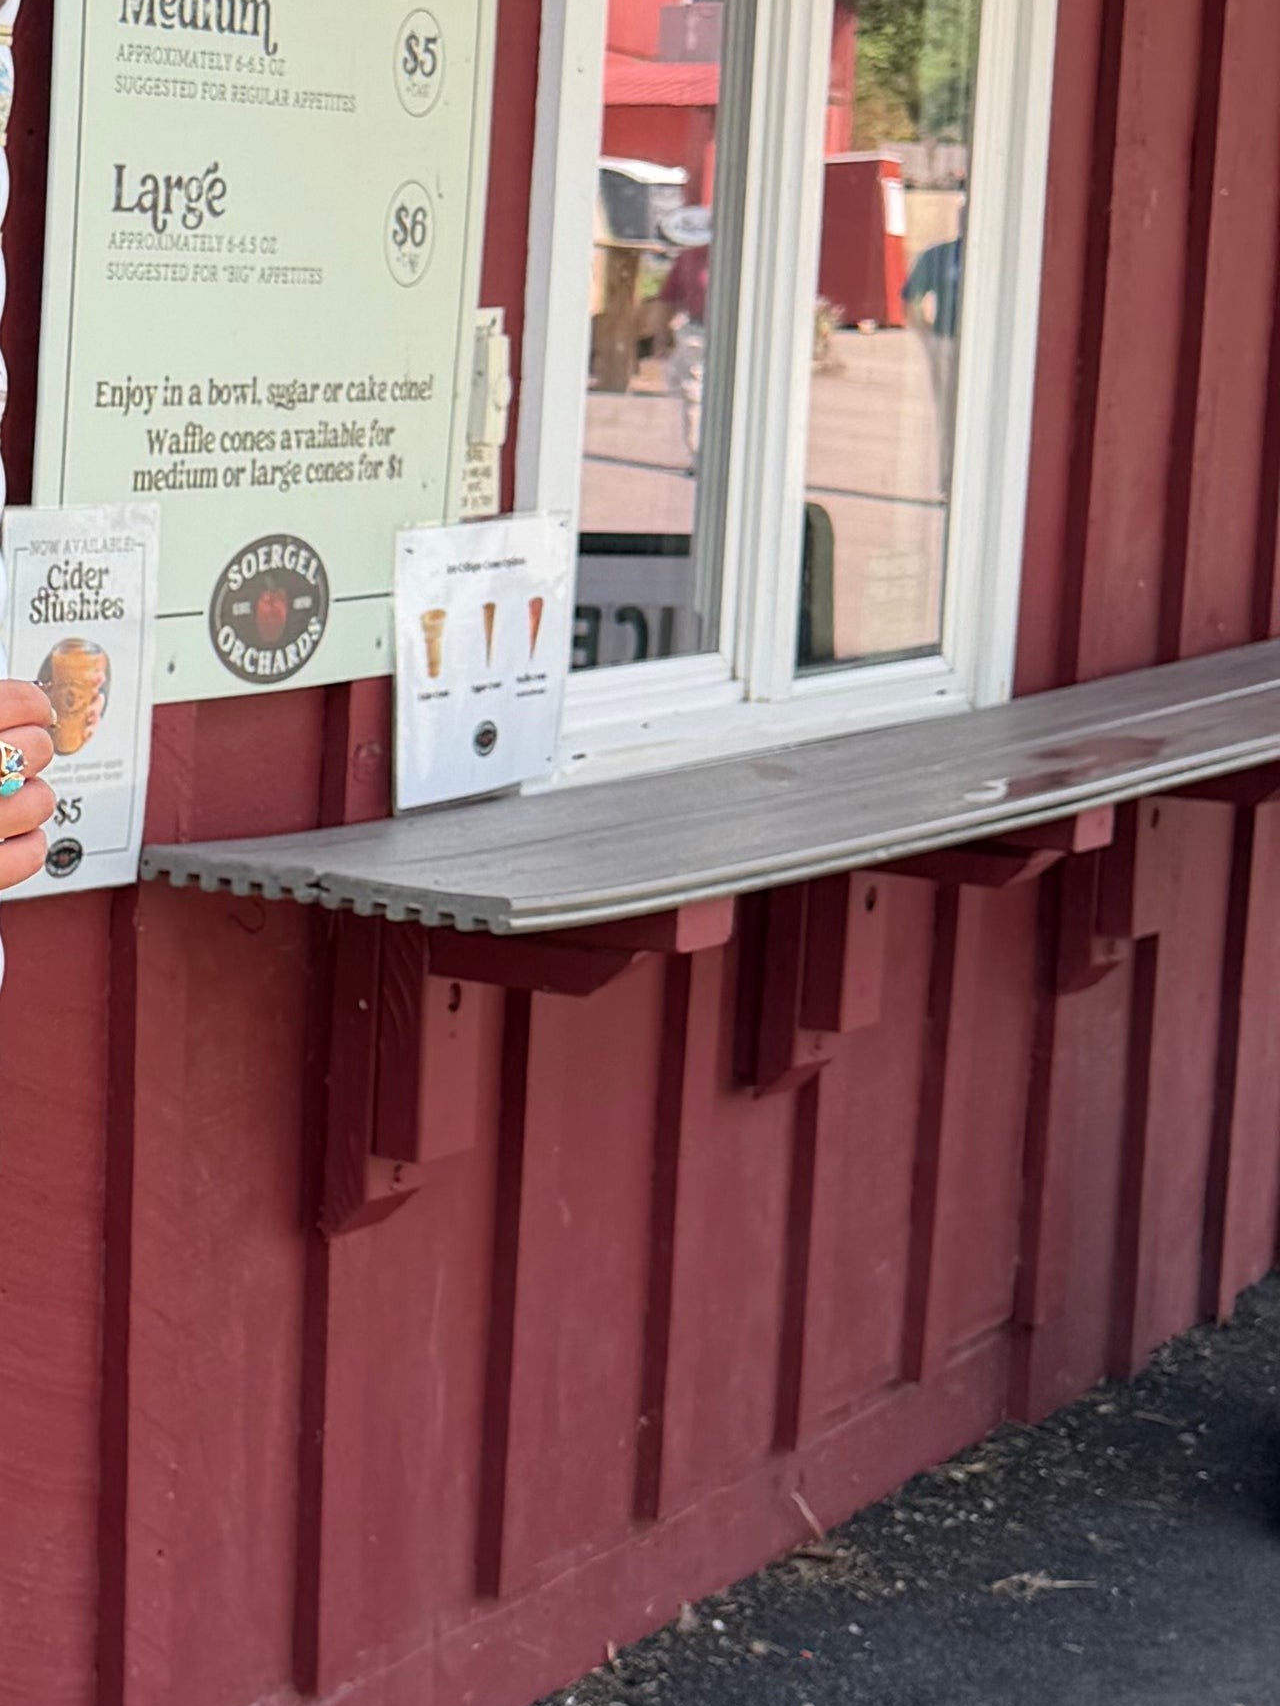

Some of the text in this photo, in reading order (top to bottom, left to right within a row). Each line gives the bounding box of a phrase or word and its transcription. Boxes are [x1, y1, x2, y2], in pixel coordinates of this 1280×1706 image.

[116, 43, 233, 71] APPROXIMATELY
[268, 59, 287, 76] OZ
[402, 29, 438, 78] $5
[114, 75, 357, 113] SUGGESTED FOR REGULAR APPETITES
[112, 162, 227, 234] Large
[107, 231, 226, 253] APPROXIMATELY
[392, 203, 428, 249] $6
[106, 261, 188, 282] SUGGESTED
[193, 263, 217, 283] FOR
[258, 266, 323, 285] APPETITES
[95, 376, 158, 416] Enjoy
[163, 376, 182, 407] in
[190, 384, 203, 406] a
[266, 378, 320, 411] sugar
[323, 380, 344, 403] or
[346, 375, 388, 402] cake
[146, 419, 396, 456] Waffle cones available for
[132, 453, 403, 493] medium or large cones for $1
[47, 559, 110, 591] Cider
[227, 543, 319, 591] SOERGEL
[29, 586, 125, 625] Slushies
[218, 616, 321, 675] ORCHARDS
[54, 797, 83, 827] $5
